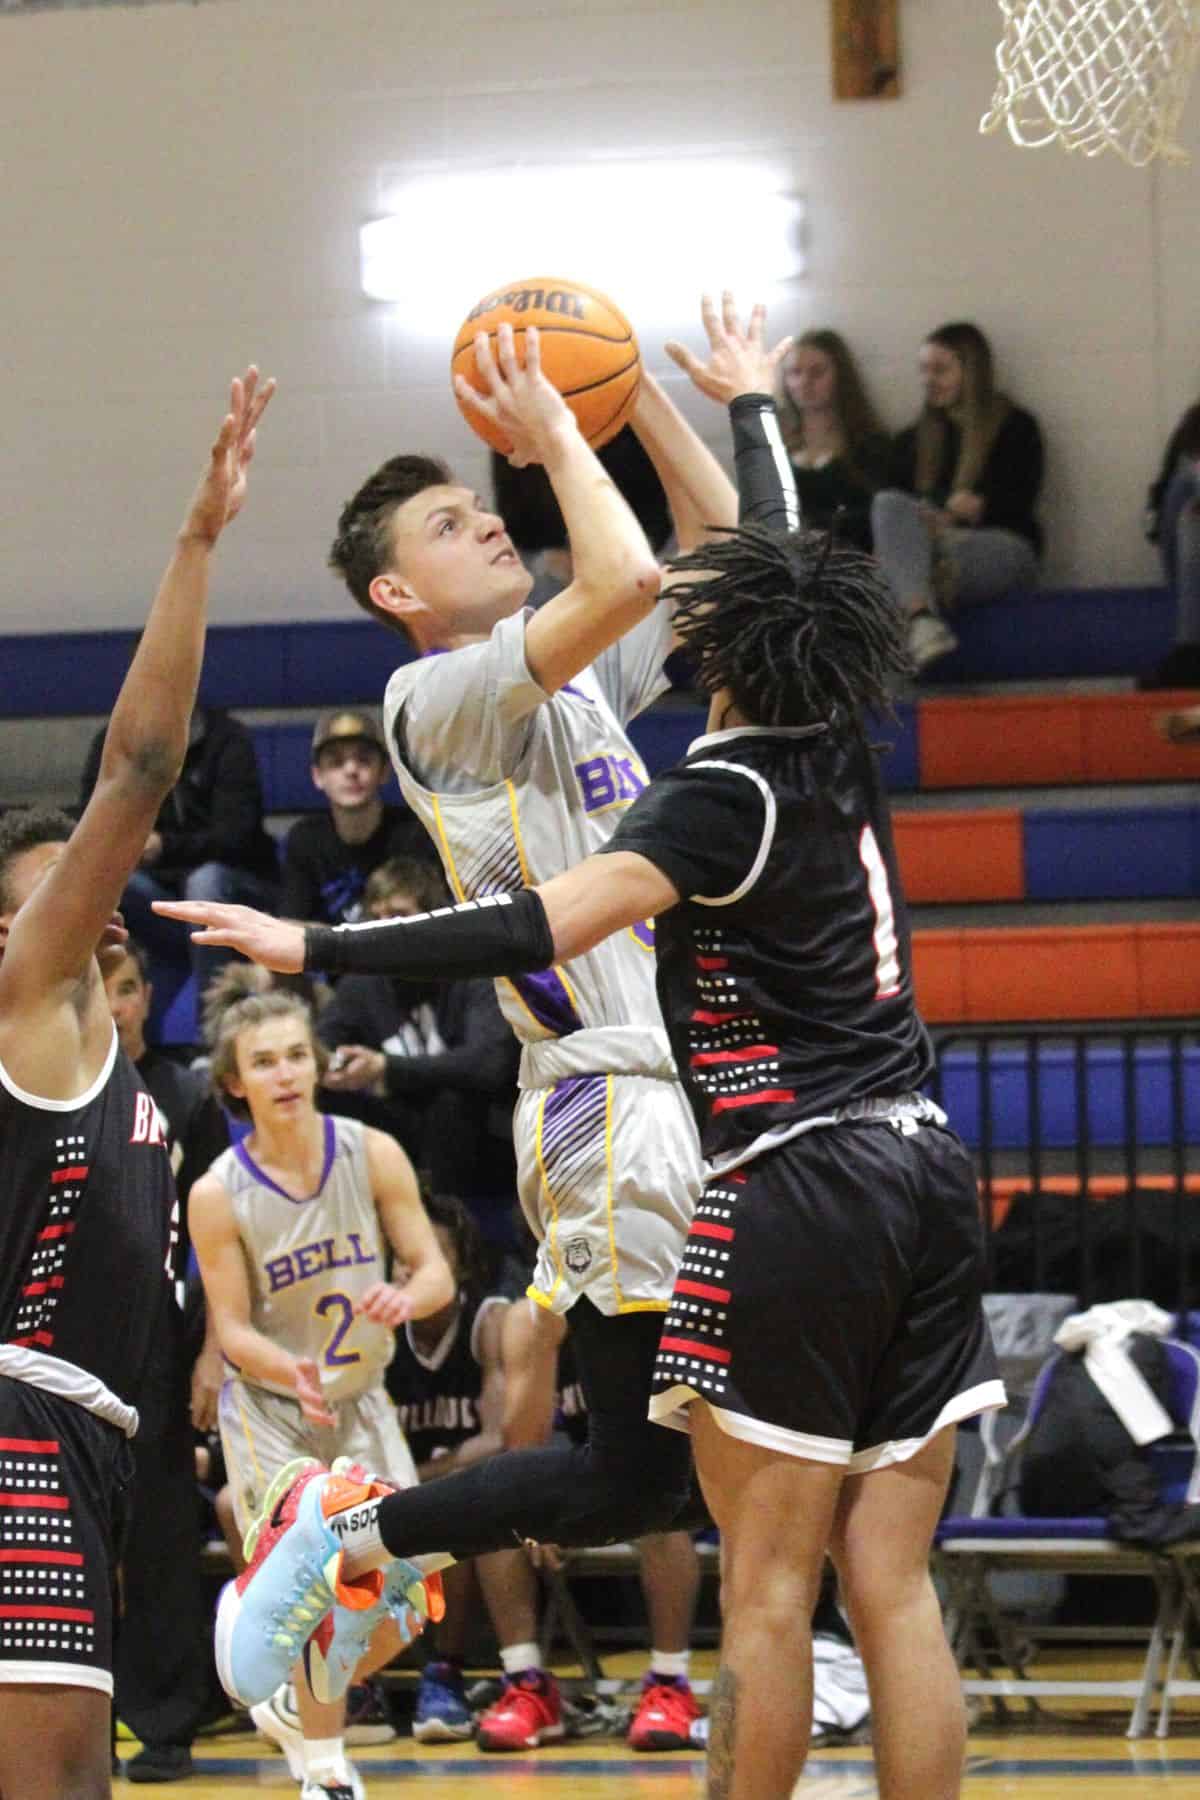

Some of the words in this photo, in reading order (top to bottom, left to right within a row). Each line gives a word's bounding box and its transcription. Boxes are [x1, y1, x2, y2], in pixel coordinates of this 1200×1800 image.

[858, 824, 900, 999] 1
[264, 1234, 376, 1293] BELL
[316, 1292, 361, 1366] 2
